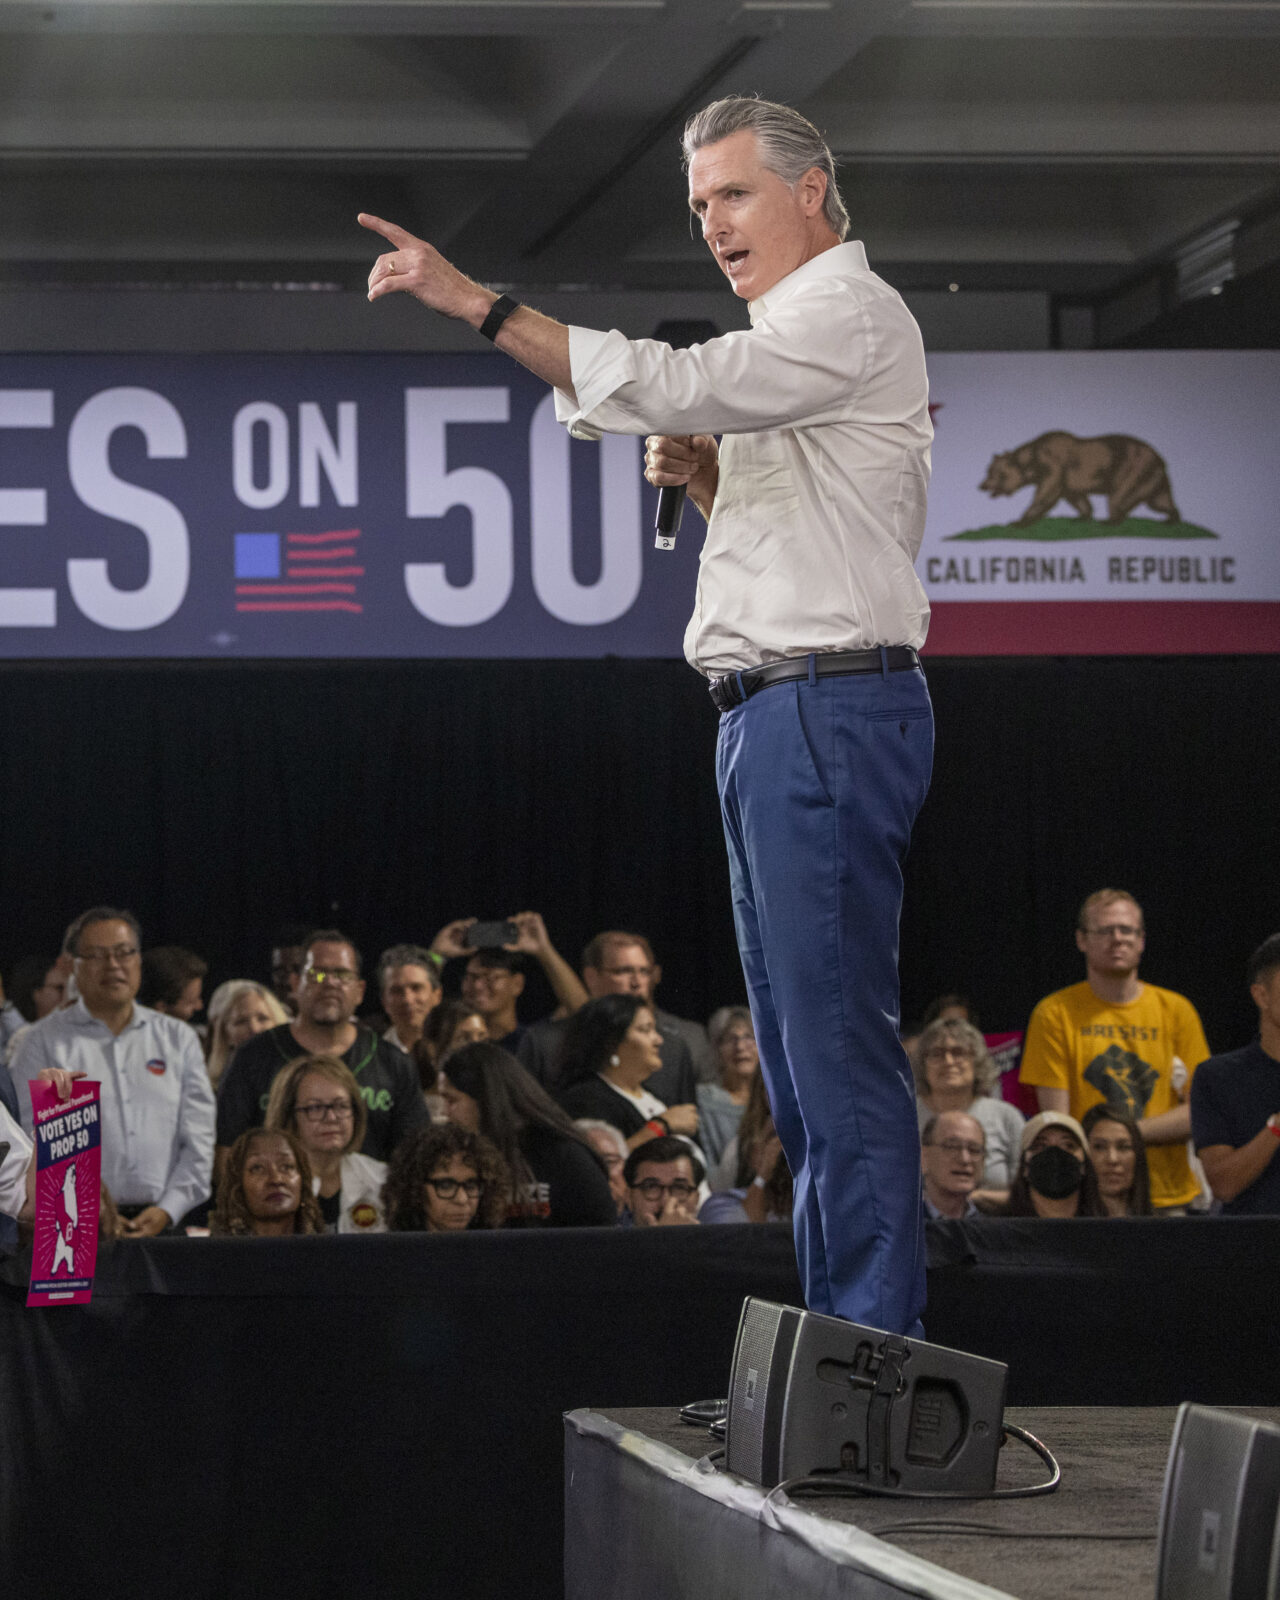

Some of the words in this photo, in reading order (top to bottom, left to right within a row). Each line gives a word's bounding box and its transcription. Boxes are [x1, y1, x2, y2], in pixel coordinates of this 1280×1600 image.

[233, 401, 359, 508] ON
[404, 386, 643, 627] 50
[926, 556, 1086, 584] CALIFORNIA
[1108, 556, 1237, 584] REPUBLIC
[39, 1118, 65, 1143] VOTE
[64, 1110, 83, 1132] YES
[83, 1104, 98, 1125] ON
[50, 1134, 76, 1160] PROP
[76, 1129, 89, 1149] 50
